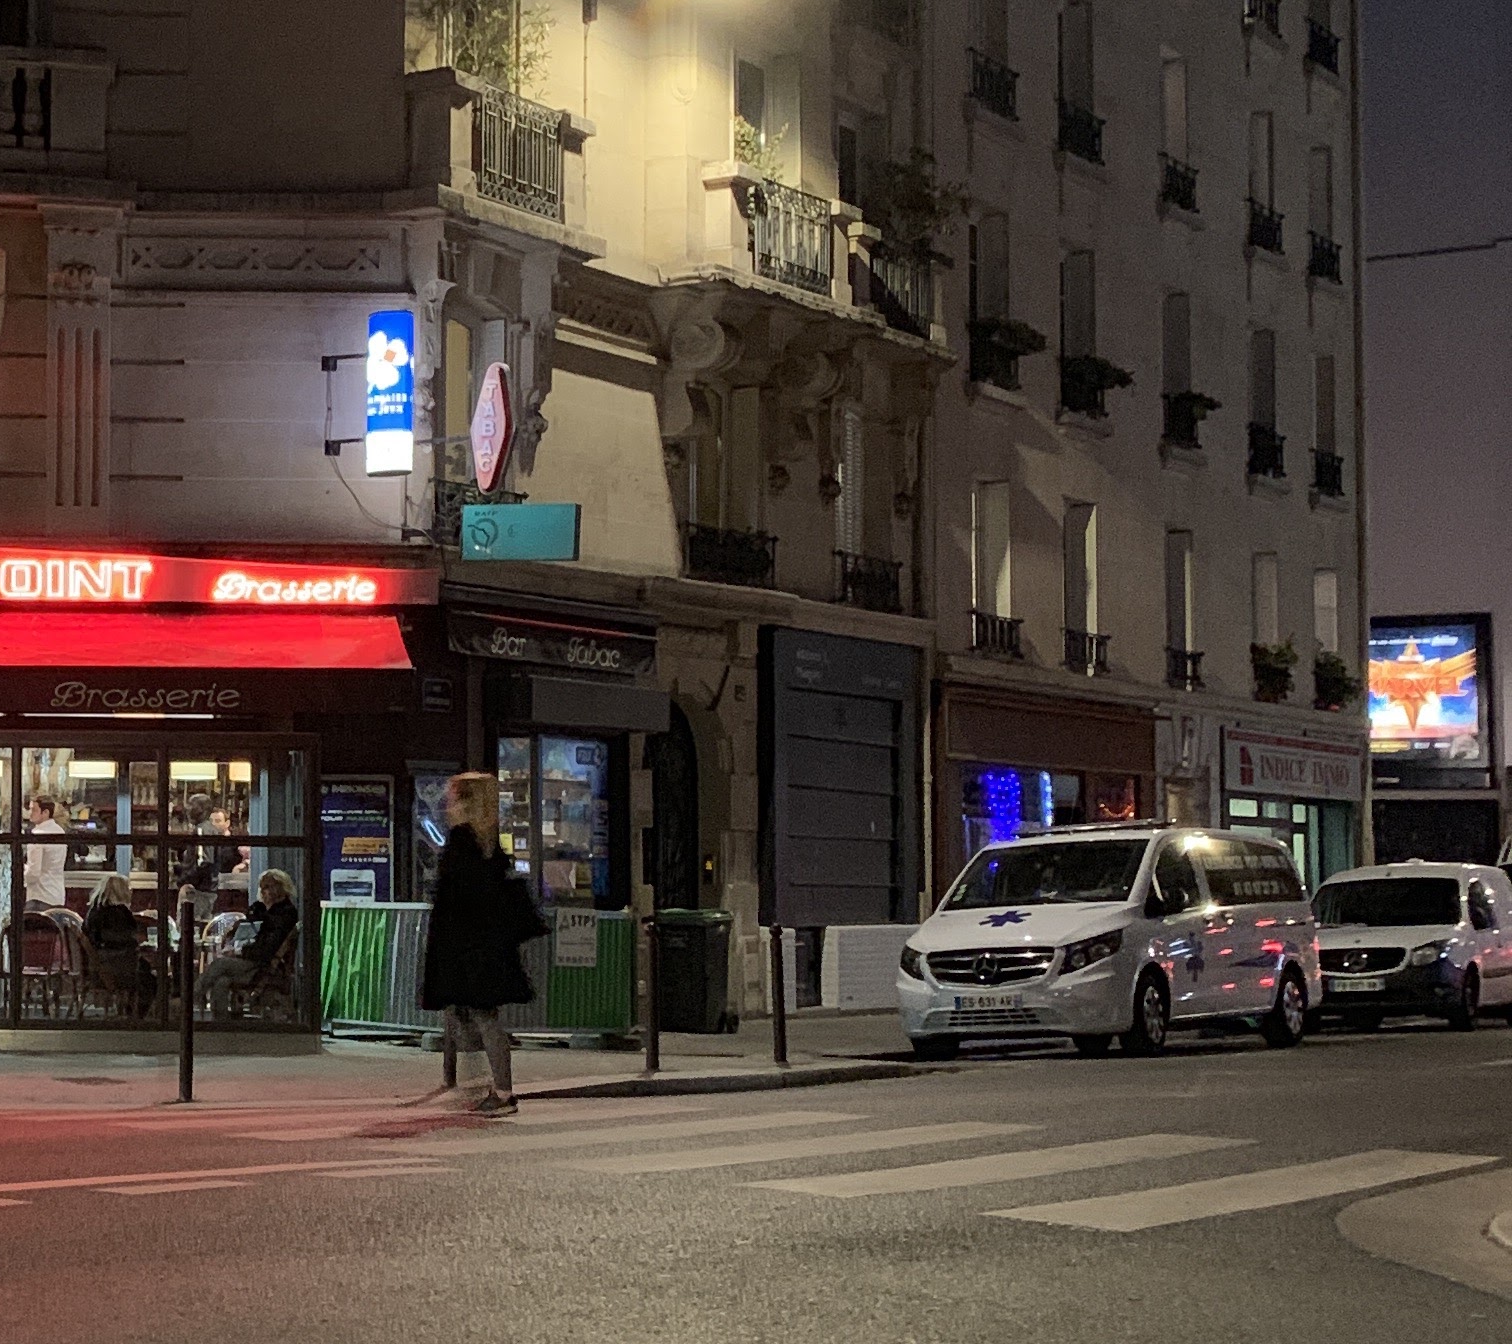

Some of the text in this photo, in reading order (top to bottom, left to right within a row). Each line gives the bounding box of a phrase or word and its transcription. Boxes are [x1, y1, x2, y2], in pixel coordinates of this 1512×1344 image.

[479, 382, 498, 472] TABAC
[212, 570, 377, 603] Brasserie
[491, 626, 621, 668] Bar Tabac
[50, 681, 240, 708] Brasserie
[1259, 754, 1308, 783] INDICE
